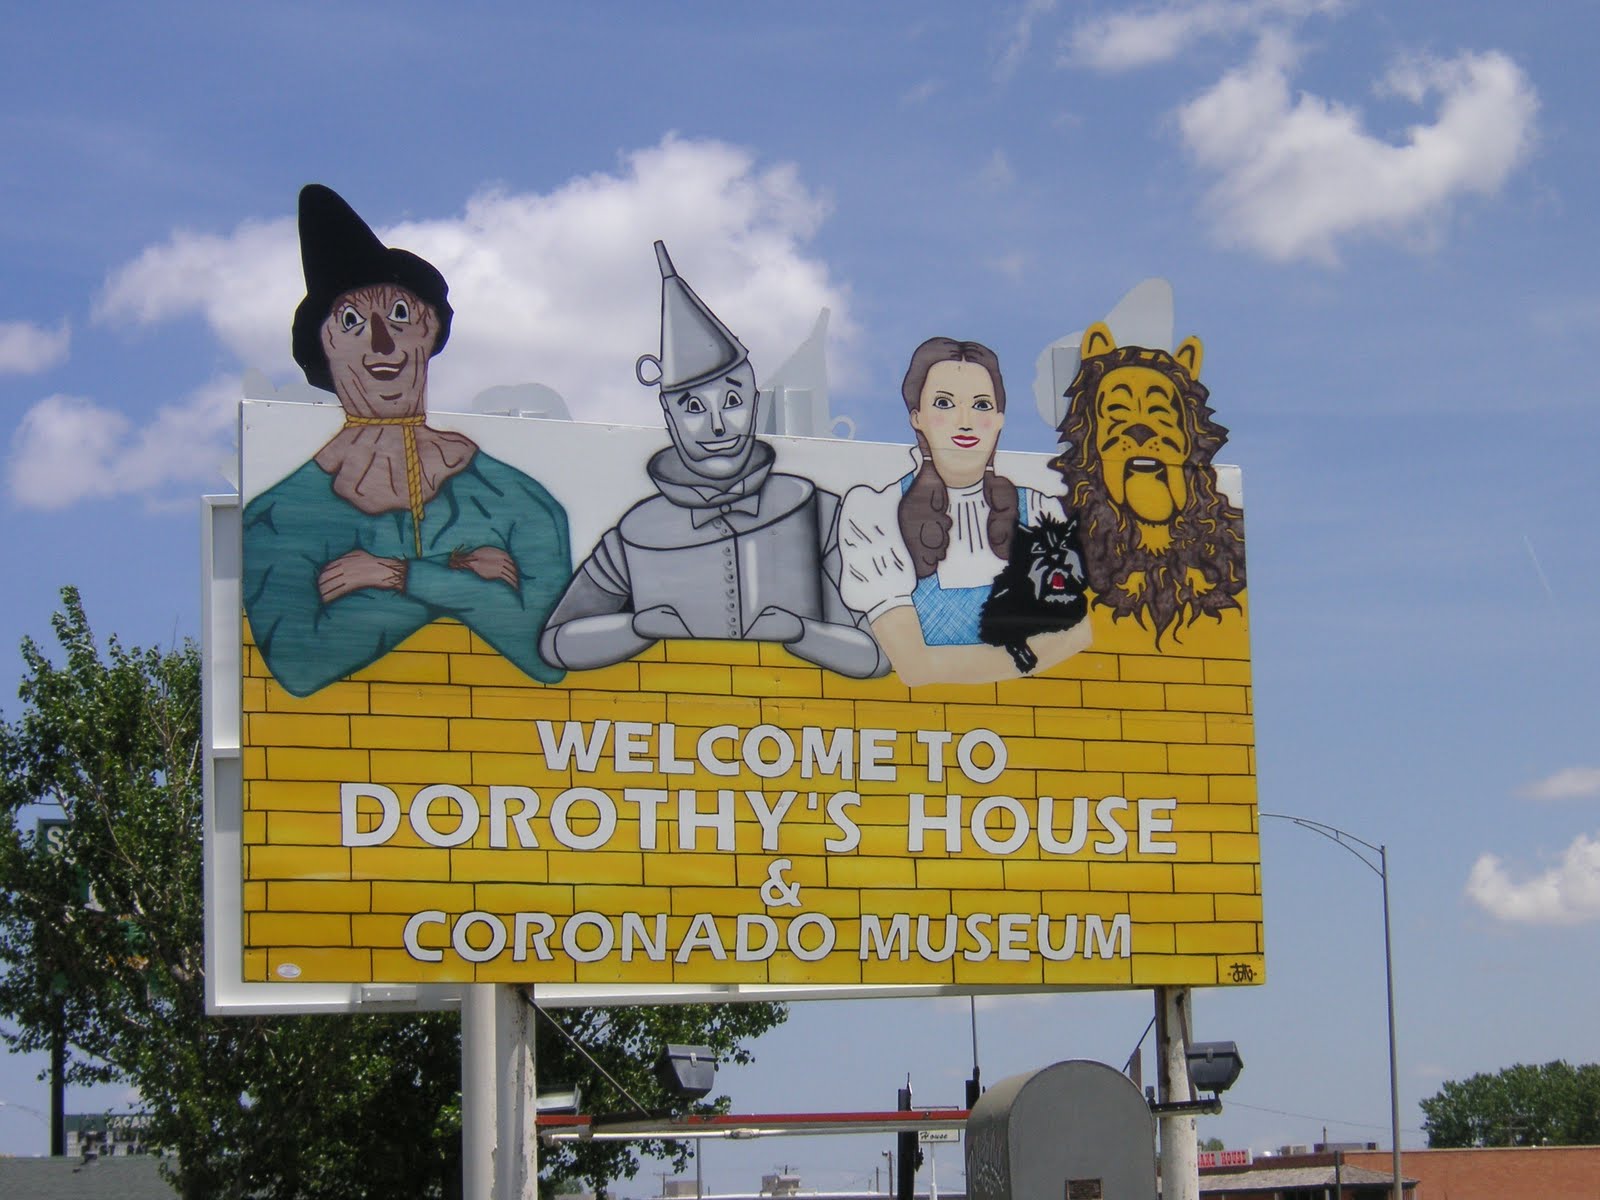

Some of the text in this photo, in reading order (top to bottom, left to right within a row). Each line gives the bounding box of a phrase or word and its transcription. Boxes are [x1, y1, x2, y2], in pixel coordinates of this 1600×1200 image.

[535, 719, 1009, 784] WELCOME TO
[339, 782, 1178, 855] DOROTHY'S HOUSE
[760, 858, 803, 907] &
[403, 910, 1132, 963] CORONADO MUSEUM
[1220, 1151, 1247, 1166] HOUSE
